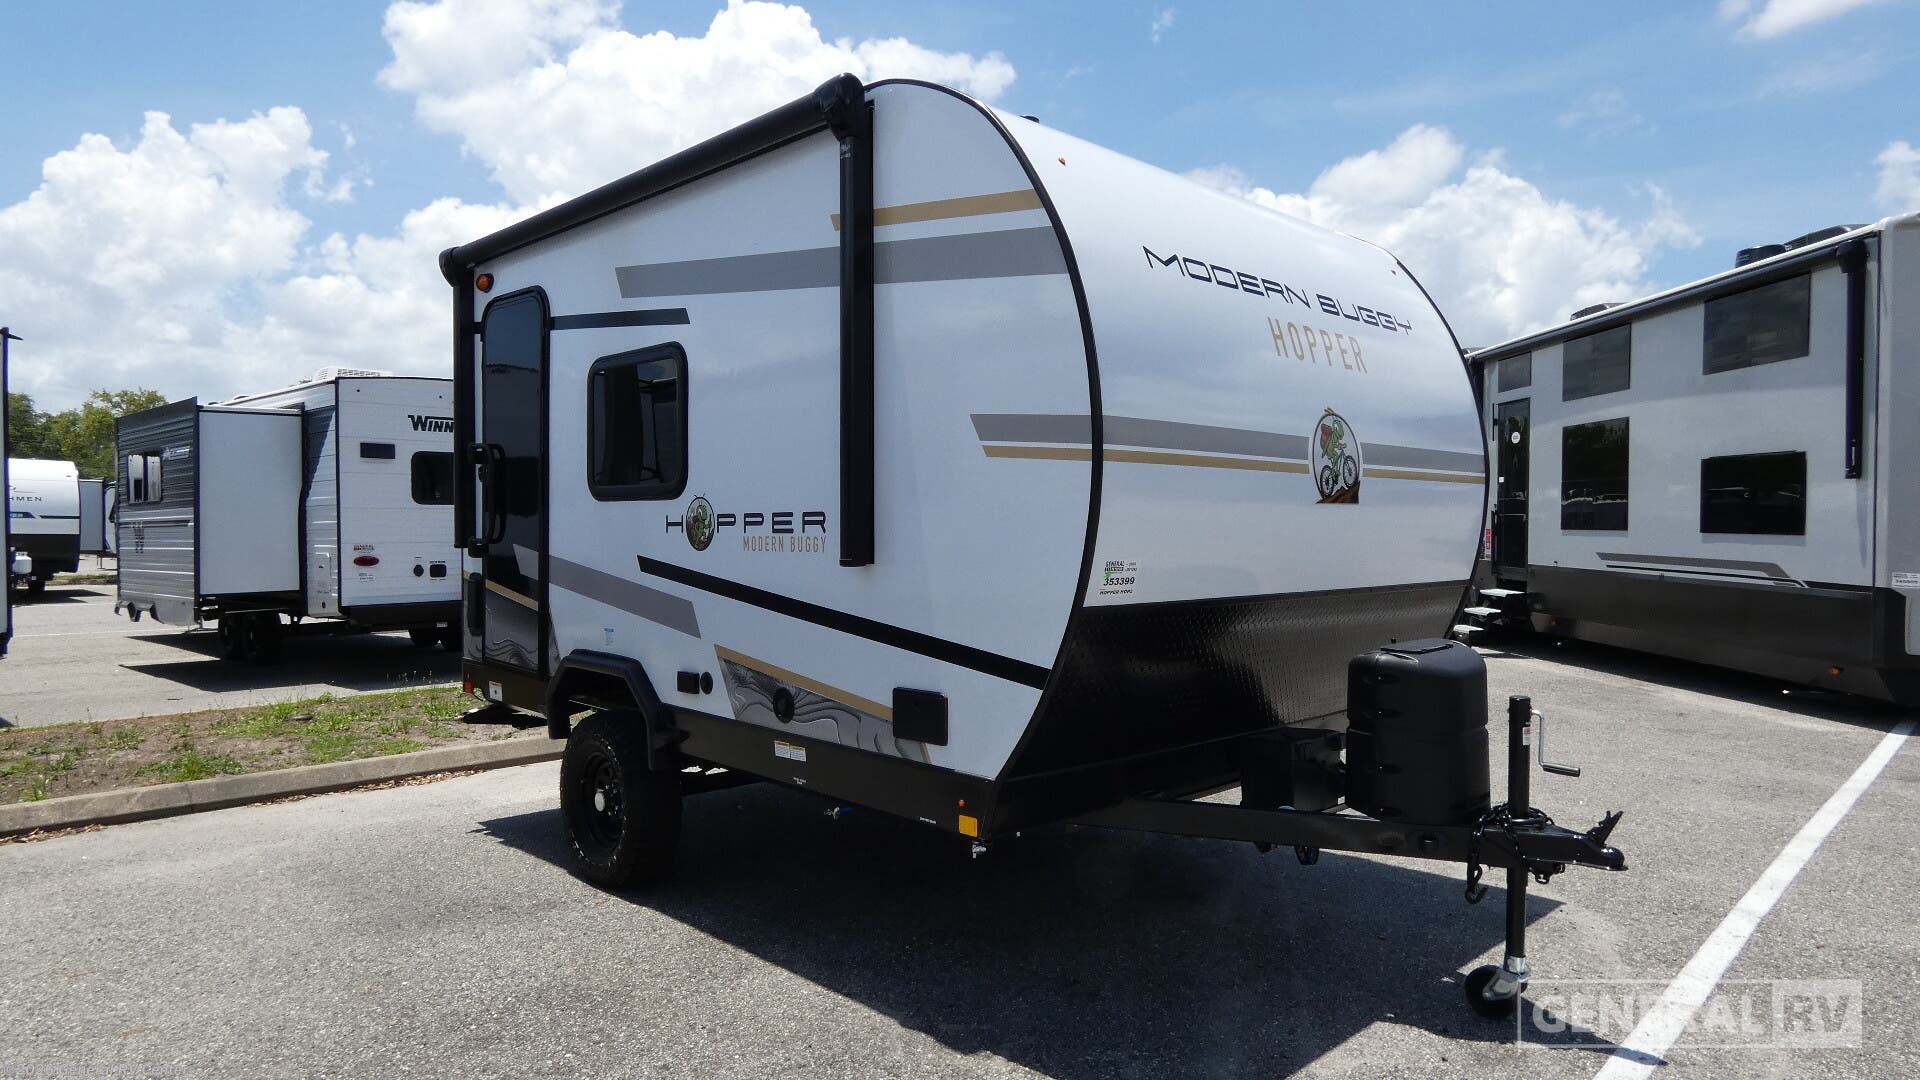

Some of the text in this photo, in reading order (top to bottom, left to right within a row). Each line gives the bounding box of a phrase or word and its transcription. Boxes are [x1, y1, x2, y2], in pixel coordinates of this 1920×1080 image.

[1142, 245, 1412, 335] MODERN BUGGY
[1267, 316, 1368, 374] HOPPER
[743, 535, 827, 553] MODERN BUGGY
[1103, 577, 1135, 586] 353399
